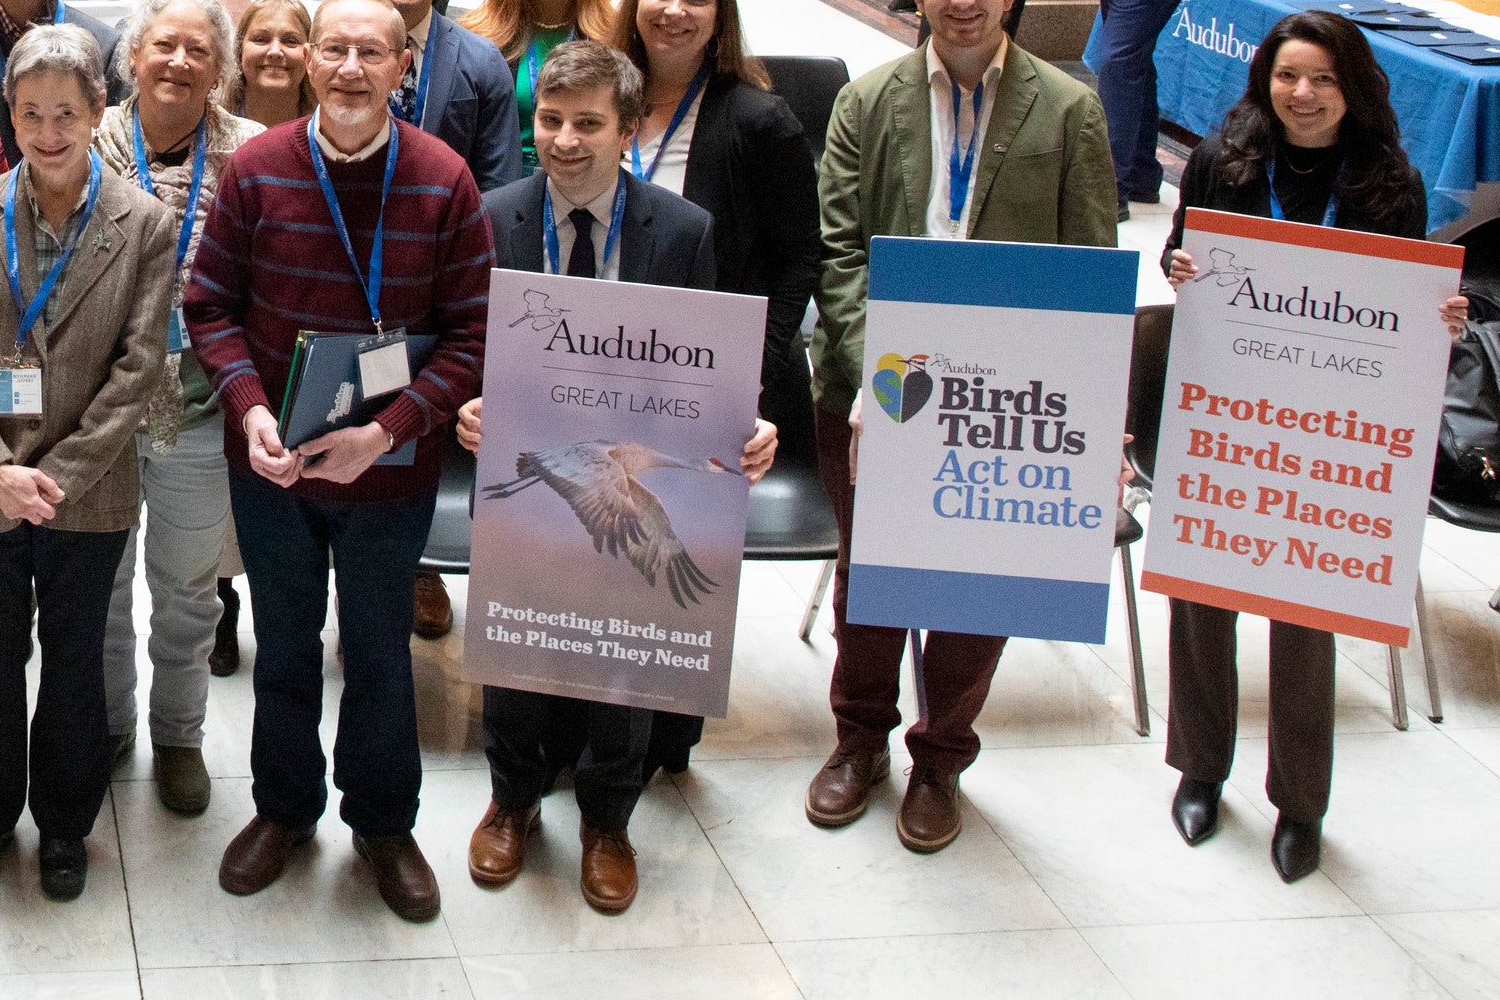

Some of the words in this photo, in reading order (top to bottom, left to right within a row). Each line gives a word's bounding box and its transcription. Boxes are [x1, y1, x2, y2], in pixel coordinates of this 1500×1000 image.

[1227, 276, 1399, 332] Audubon
[543, 318, 715, 369] Audubon
[1232, 338, 1304, 364] GREAT
[1310, 351, 1382, 378] LAKES
[943, 362, 996, 376] Audubon
[550, 385, 623, 409] GREAT
[629, 393, 700, 419] LAKES
[939, 377, 1067, 417] Birds
[1178, 382, 1415, 458] Protecting
[937, 413, 1024, 451] Tell
[1032, 419, 1086, 455] Us
[933, 450, 1009, 486] Act
[1018, 464, 1072, 491] on
[1187, 428, 1301, 475] Birds
[1310, 459, 1393, 493] and
[933, 485, 1102, 529] Climate
[1177, 472, 1247, 509] the
[1254, 486, 1392, 539] Places
[1173, 514, 1278, 566] They
[1284, 536, 1393, 585] Need
[487, 601, 604, 635] Protecting
[608, 618, 666, 641] Birds
[670, 631, 712, 647] and
[485, 625, 521, 644] the
[525, 630, 593, 654] Places
[598, 640, 652, 666] They
[655, 648, 710, 671] Need
